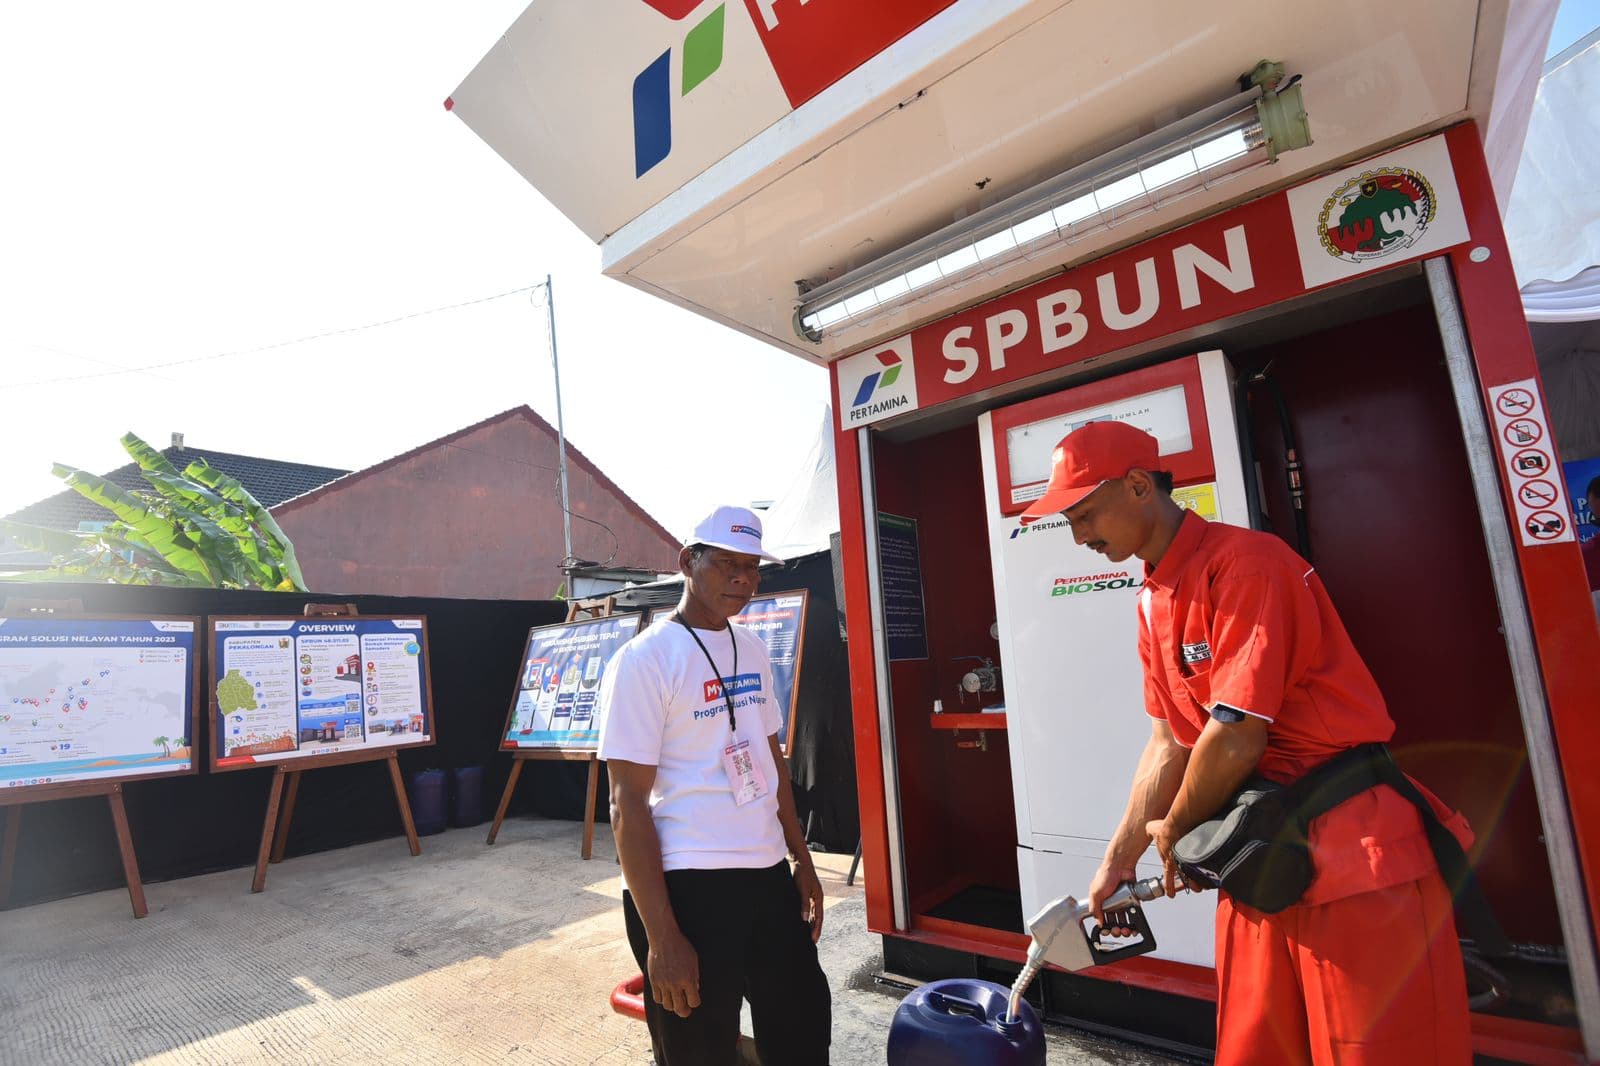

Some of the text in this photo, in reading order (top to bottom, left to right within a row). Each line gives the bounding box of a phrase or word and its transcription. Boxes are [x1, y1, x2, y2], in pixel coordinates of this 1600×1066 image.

[941, 224, 1255, 385] SPBUN
[850, 395, 909, 421] PERTAMINA
[1032, 520, 1072, 532] PERTAMIN
[1054, 571, 1129, 585] PERTAMINA
[298, 624, 356, 633] OVERVIEW
[0, 635, 28, 643] RAM
[31, 635, 69, 643] SOLUSI
[72, 635, 118, 643] NELAYAN
[599, 631, 620, 640] TEPAT
